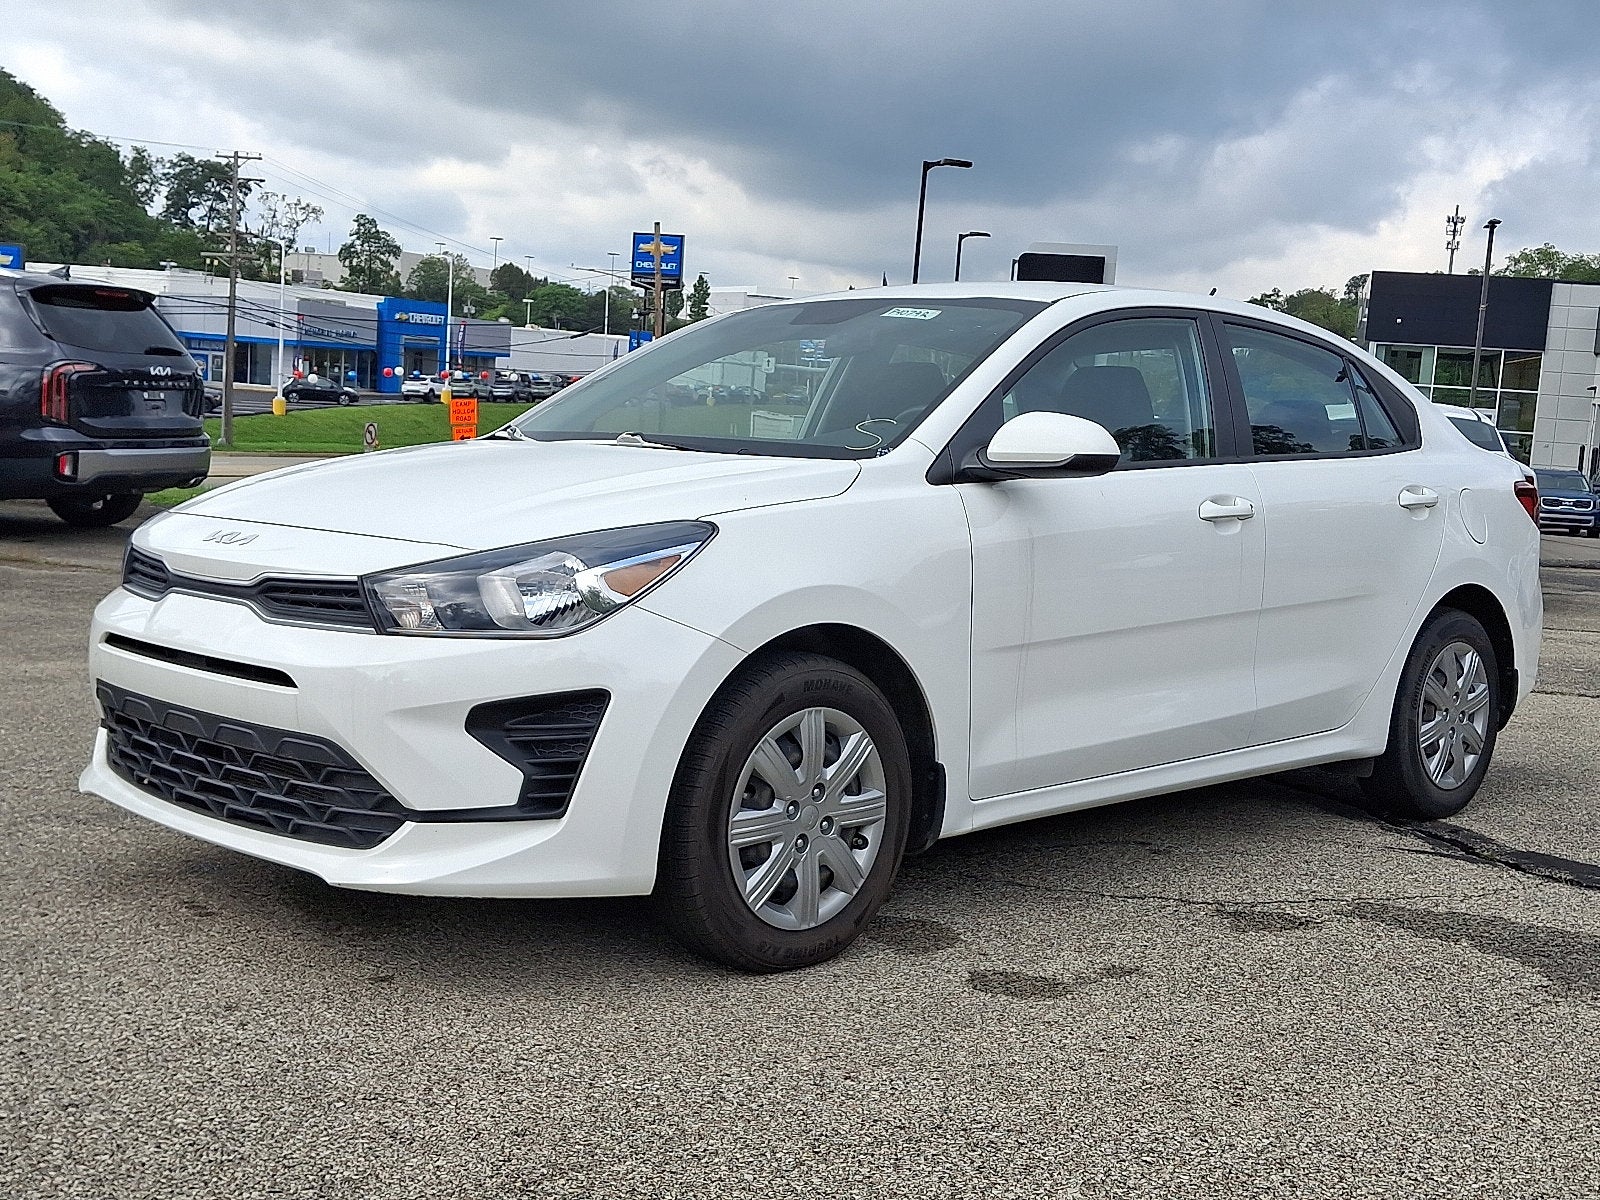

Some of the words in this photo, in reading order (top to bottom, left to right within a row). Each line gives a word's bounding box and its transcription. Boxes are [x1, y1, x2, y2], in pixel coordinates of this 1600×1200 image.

[635, 260, 678, 270] CHEVOLET
[409, 312, 445, 325] CHEVROLET
[149, 366, 172, 376] KIA
[202, 529, 260, 547] KIA
